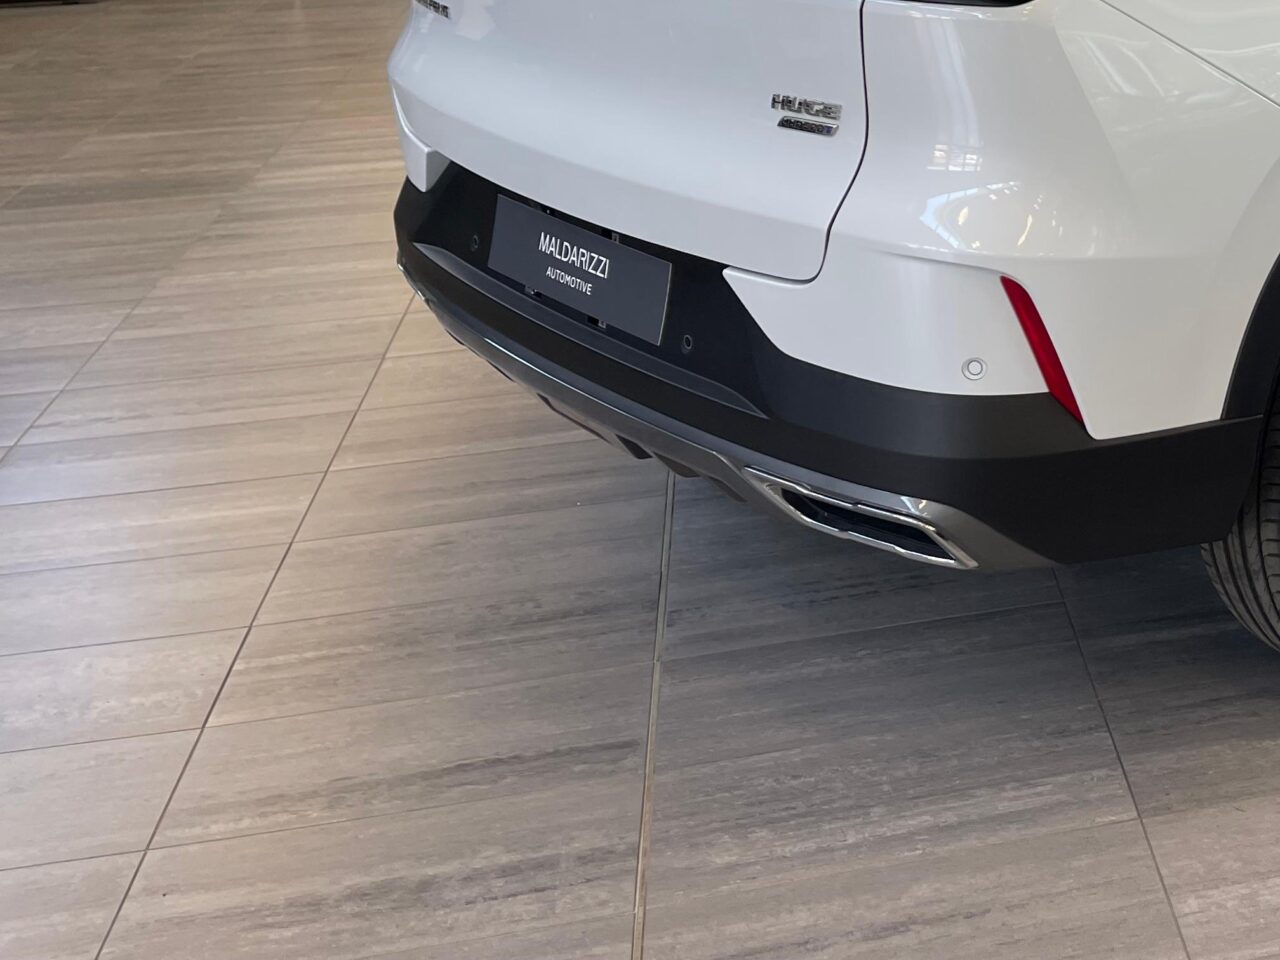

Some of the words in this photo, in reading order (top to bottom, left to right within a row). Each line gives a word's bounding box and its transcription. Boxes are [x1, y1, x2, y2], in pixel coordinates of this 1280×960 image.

[771, 93, 843, 121] HUGE
[538, 231, 610, 279] MALDARIZZI
[545, 266, 593, 296] AUTOMOTIVE
